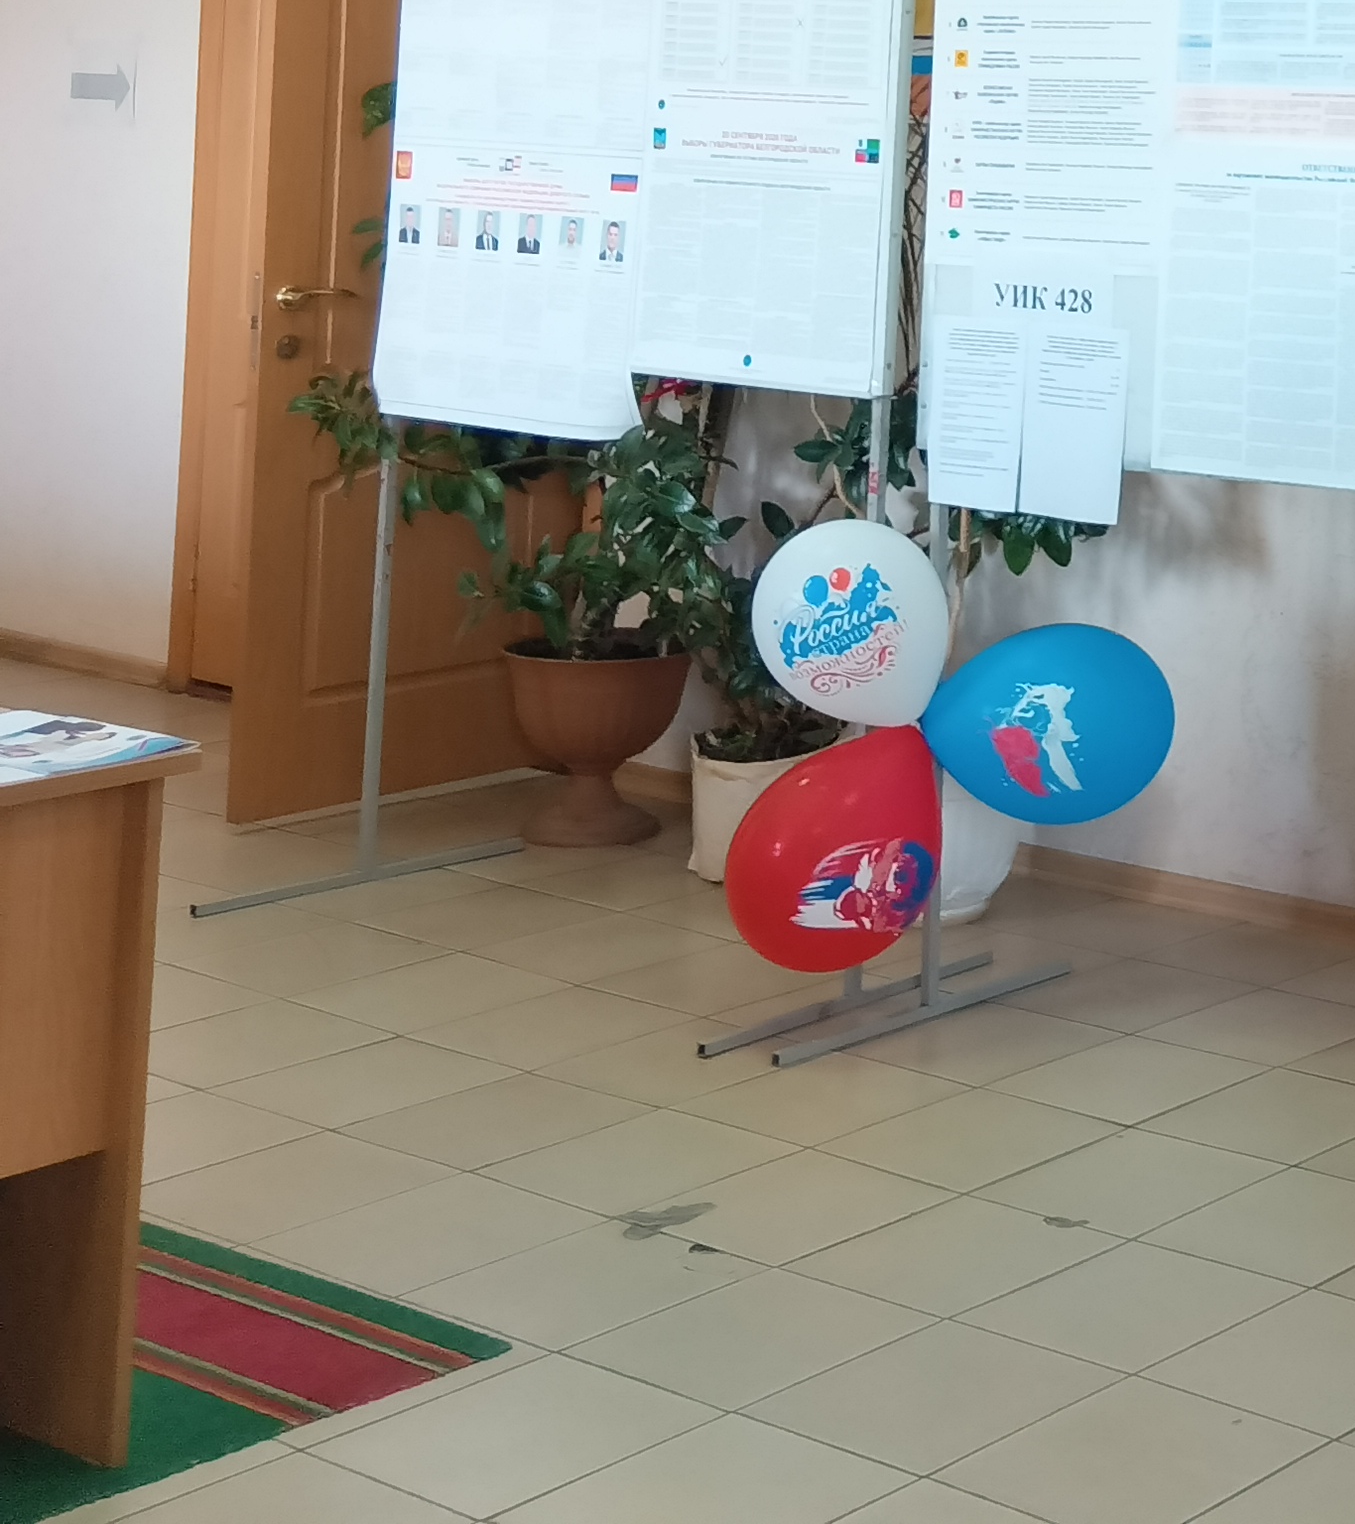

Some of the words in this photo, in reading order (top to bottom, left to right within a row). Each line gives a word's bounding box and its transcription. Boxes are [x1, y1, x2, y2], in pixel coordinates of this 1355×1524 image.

[994, 282, 1049, 311] УИК
[1054, 288, 1094, 314] 428
[780, 600, 878, 655] Россия
[810, 624, 872, 659] страна
